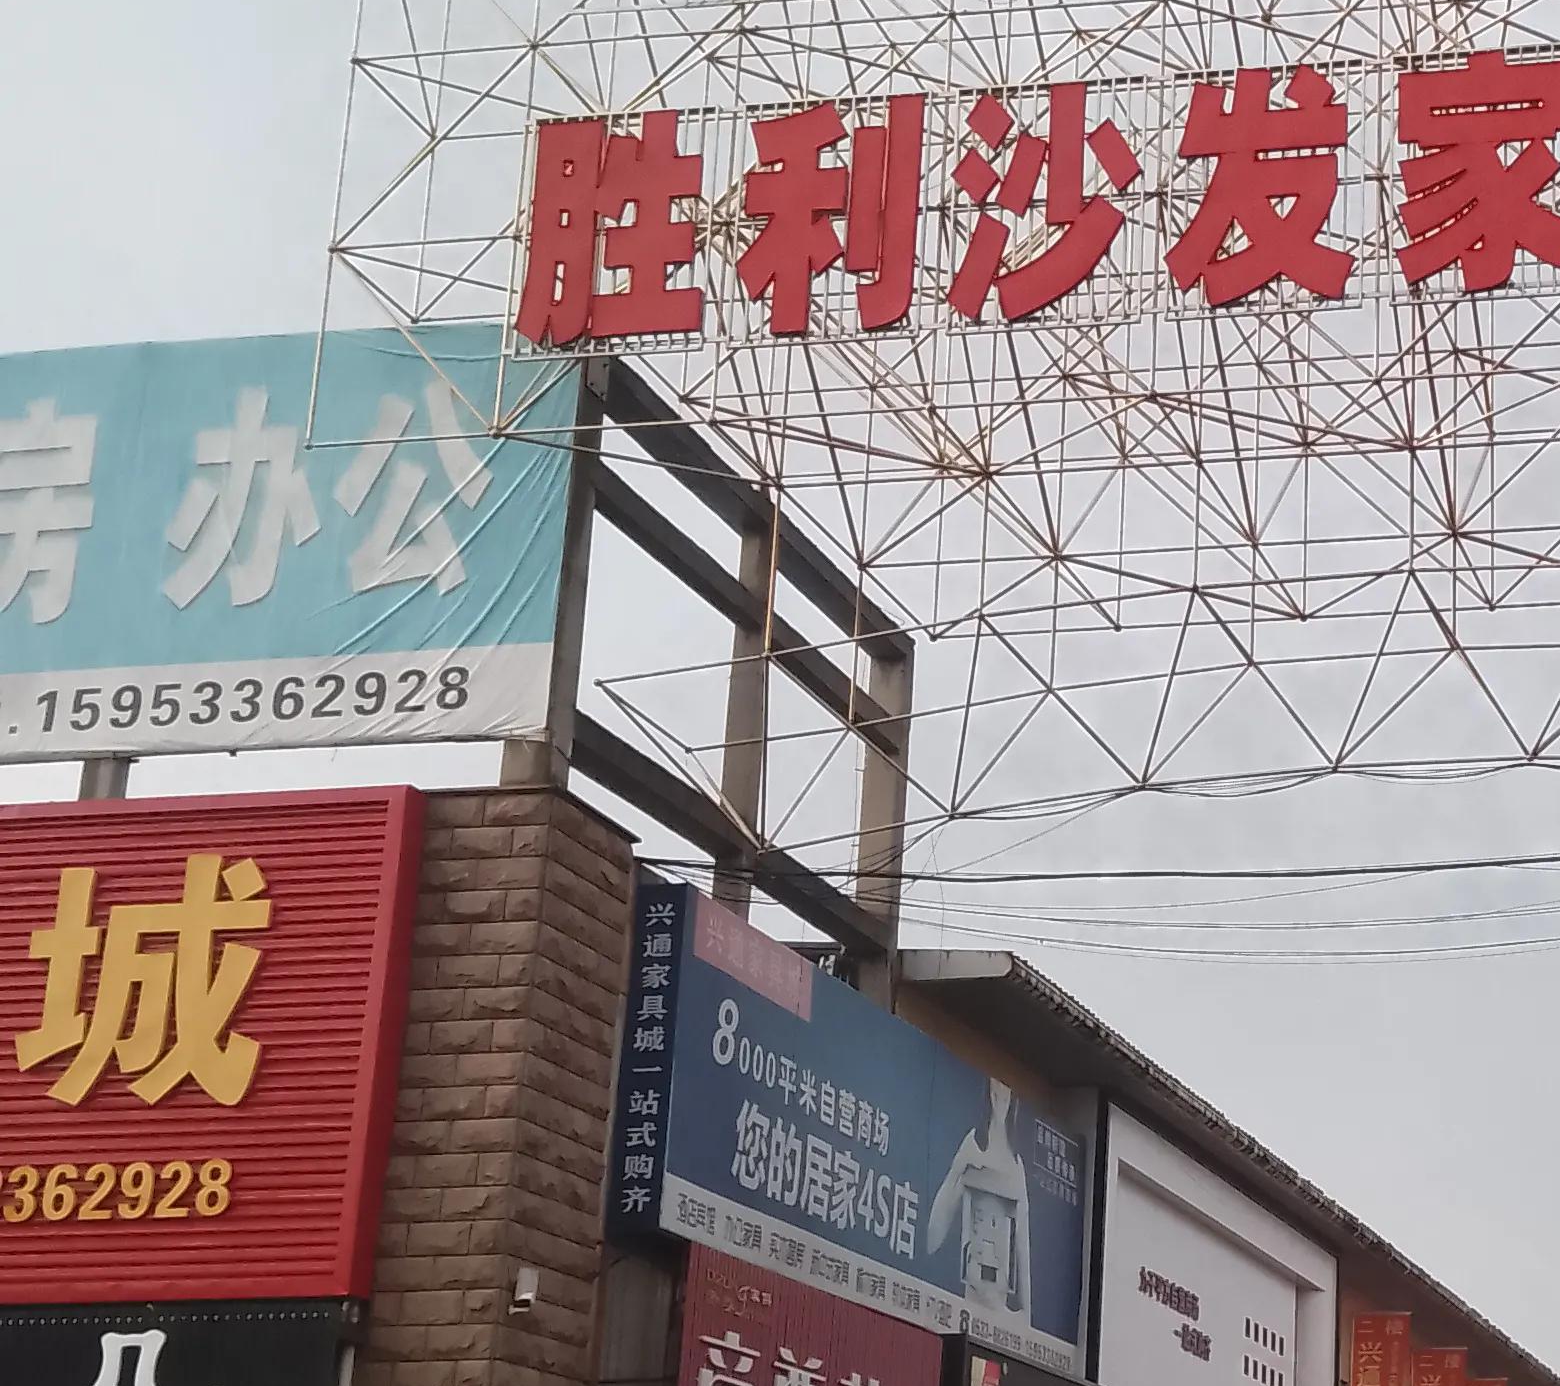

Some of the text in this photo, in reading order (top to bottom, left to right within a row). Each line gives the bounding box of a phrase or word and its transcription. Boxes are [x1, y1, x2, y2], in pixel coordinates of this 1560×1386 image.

[14, 853, 275, 1106] 城
[0, 1158, 233, 1222] 362928
[731, 1099, 920, 1261] 您的居家4S店
